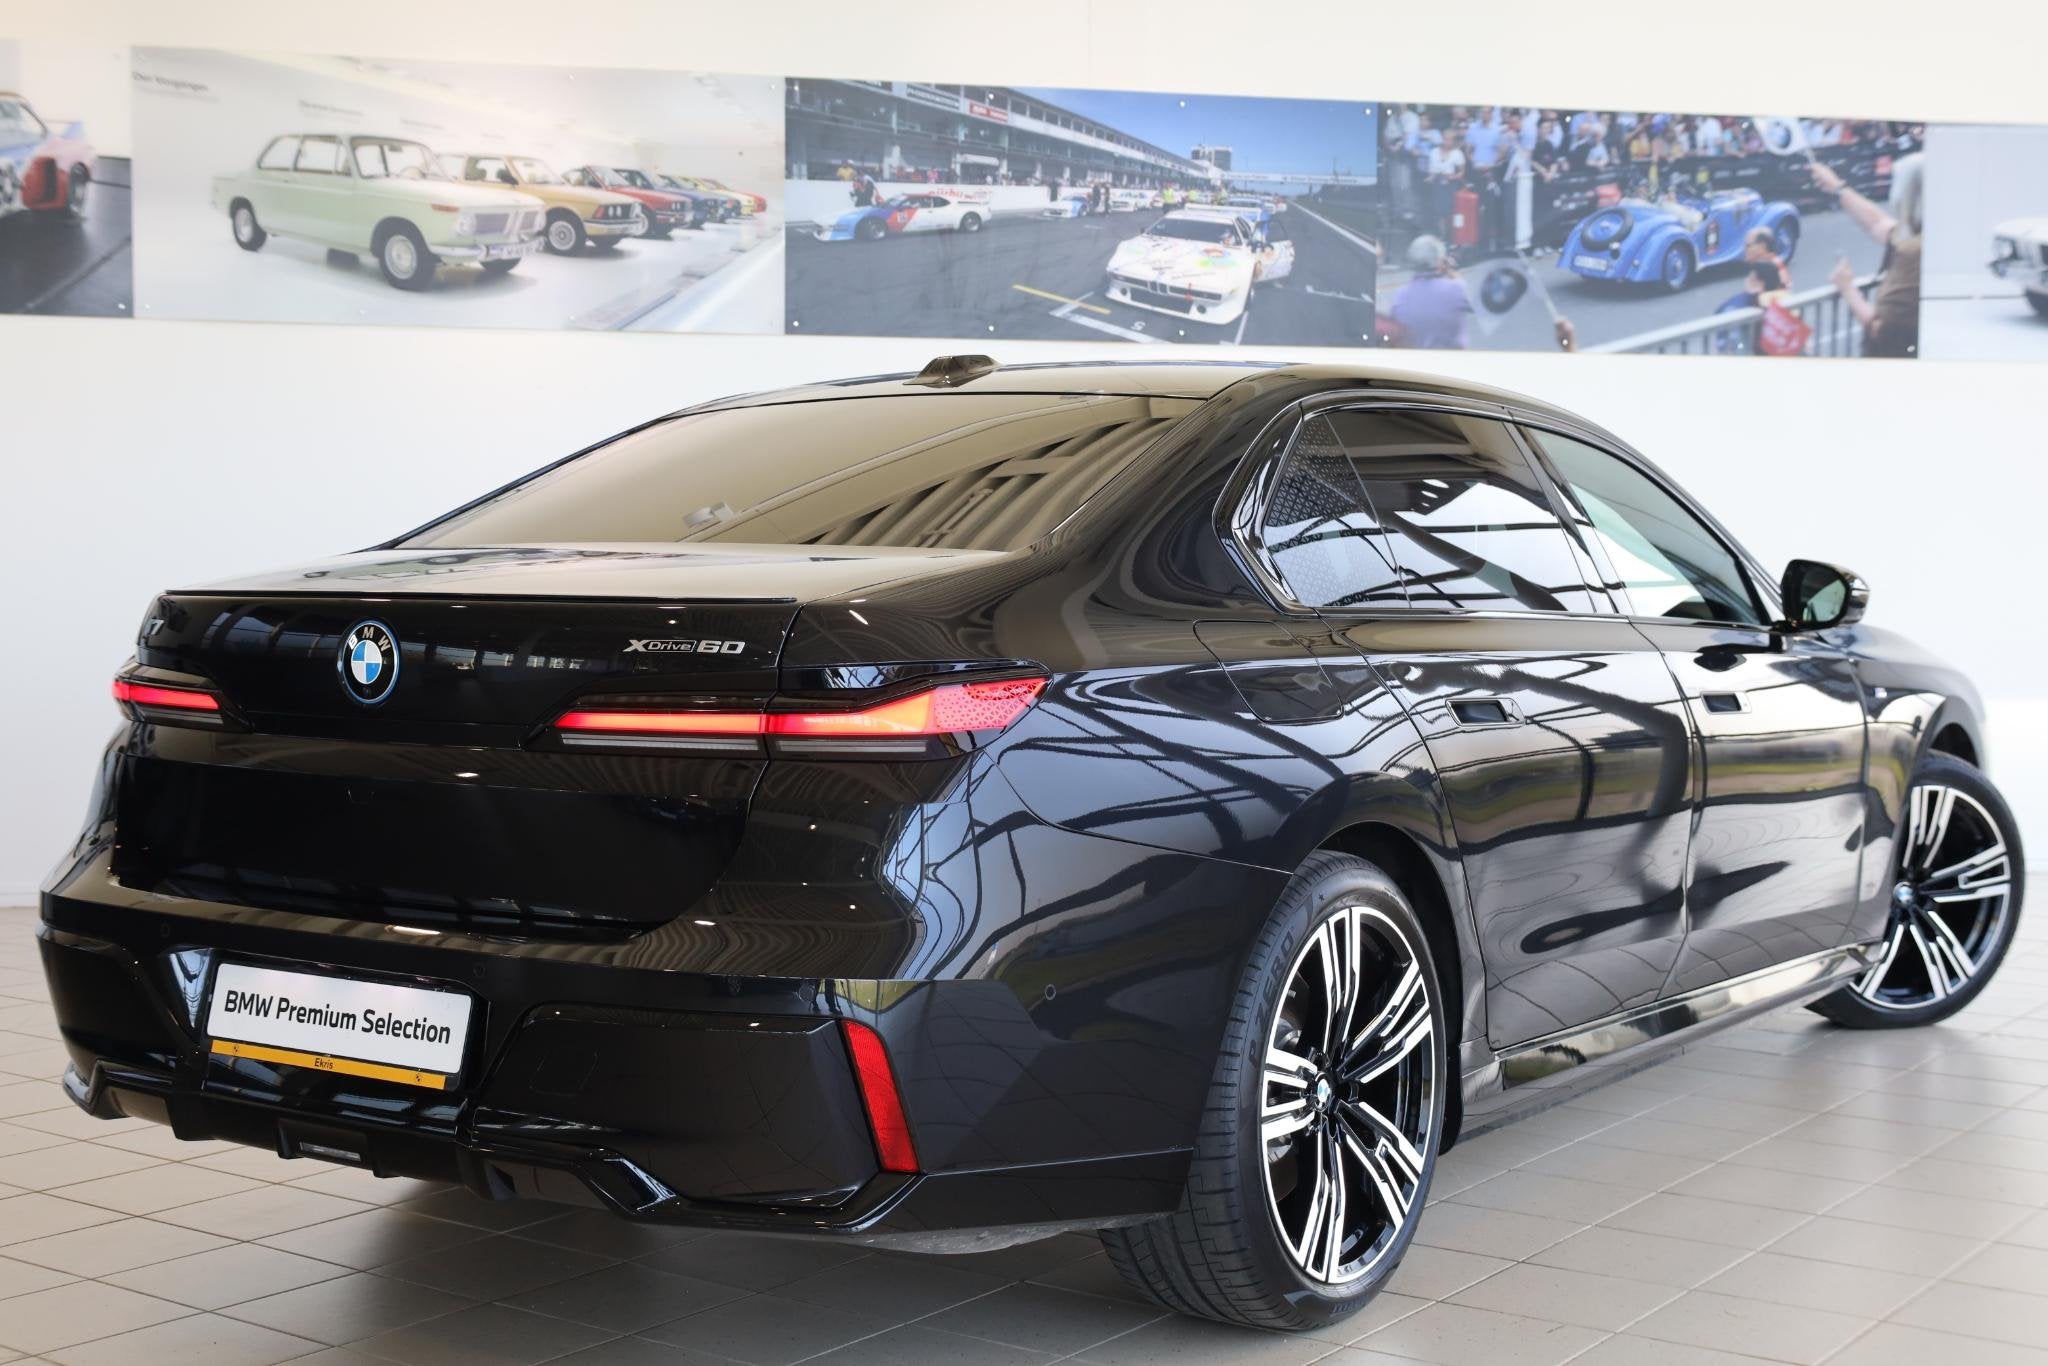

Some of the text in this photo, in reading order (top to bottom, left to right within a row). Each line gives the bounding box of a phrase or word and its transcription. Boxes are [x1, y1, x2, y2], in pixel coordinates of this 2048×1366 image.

[348, 626, 391, 652] BMW
[698, 640, 745, 654] 60
[224, 989, 451, 1044] BMW Premium Selection
[314, 1057, 334, 1070] Ekris
